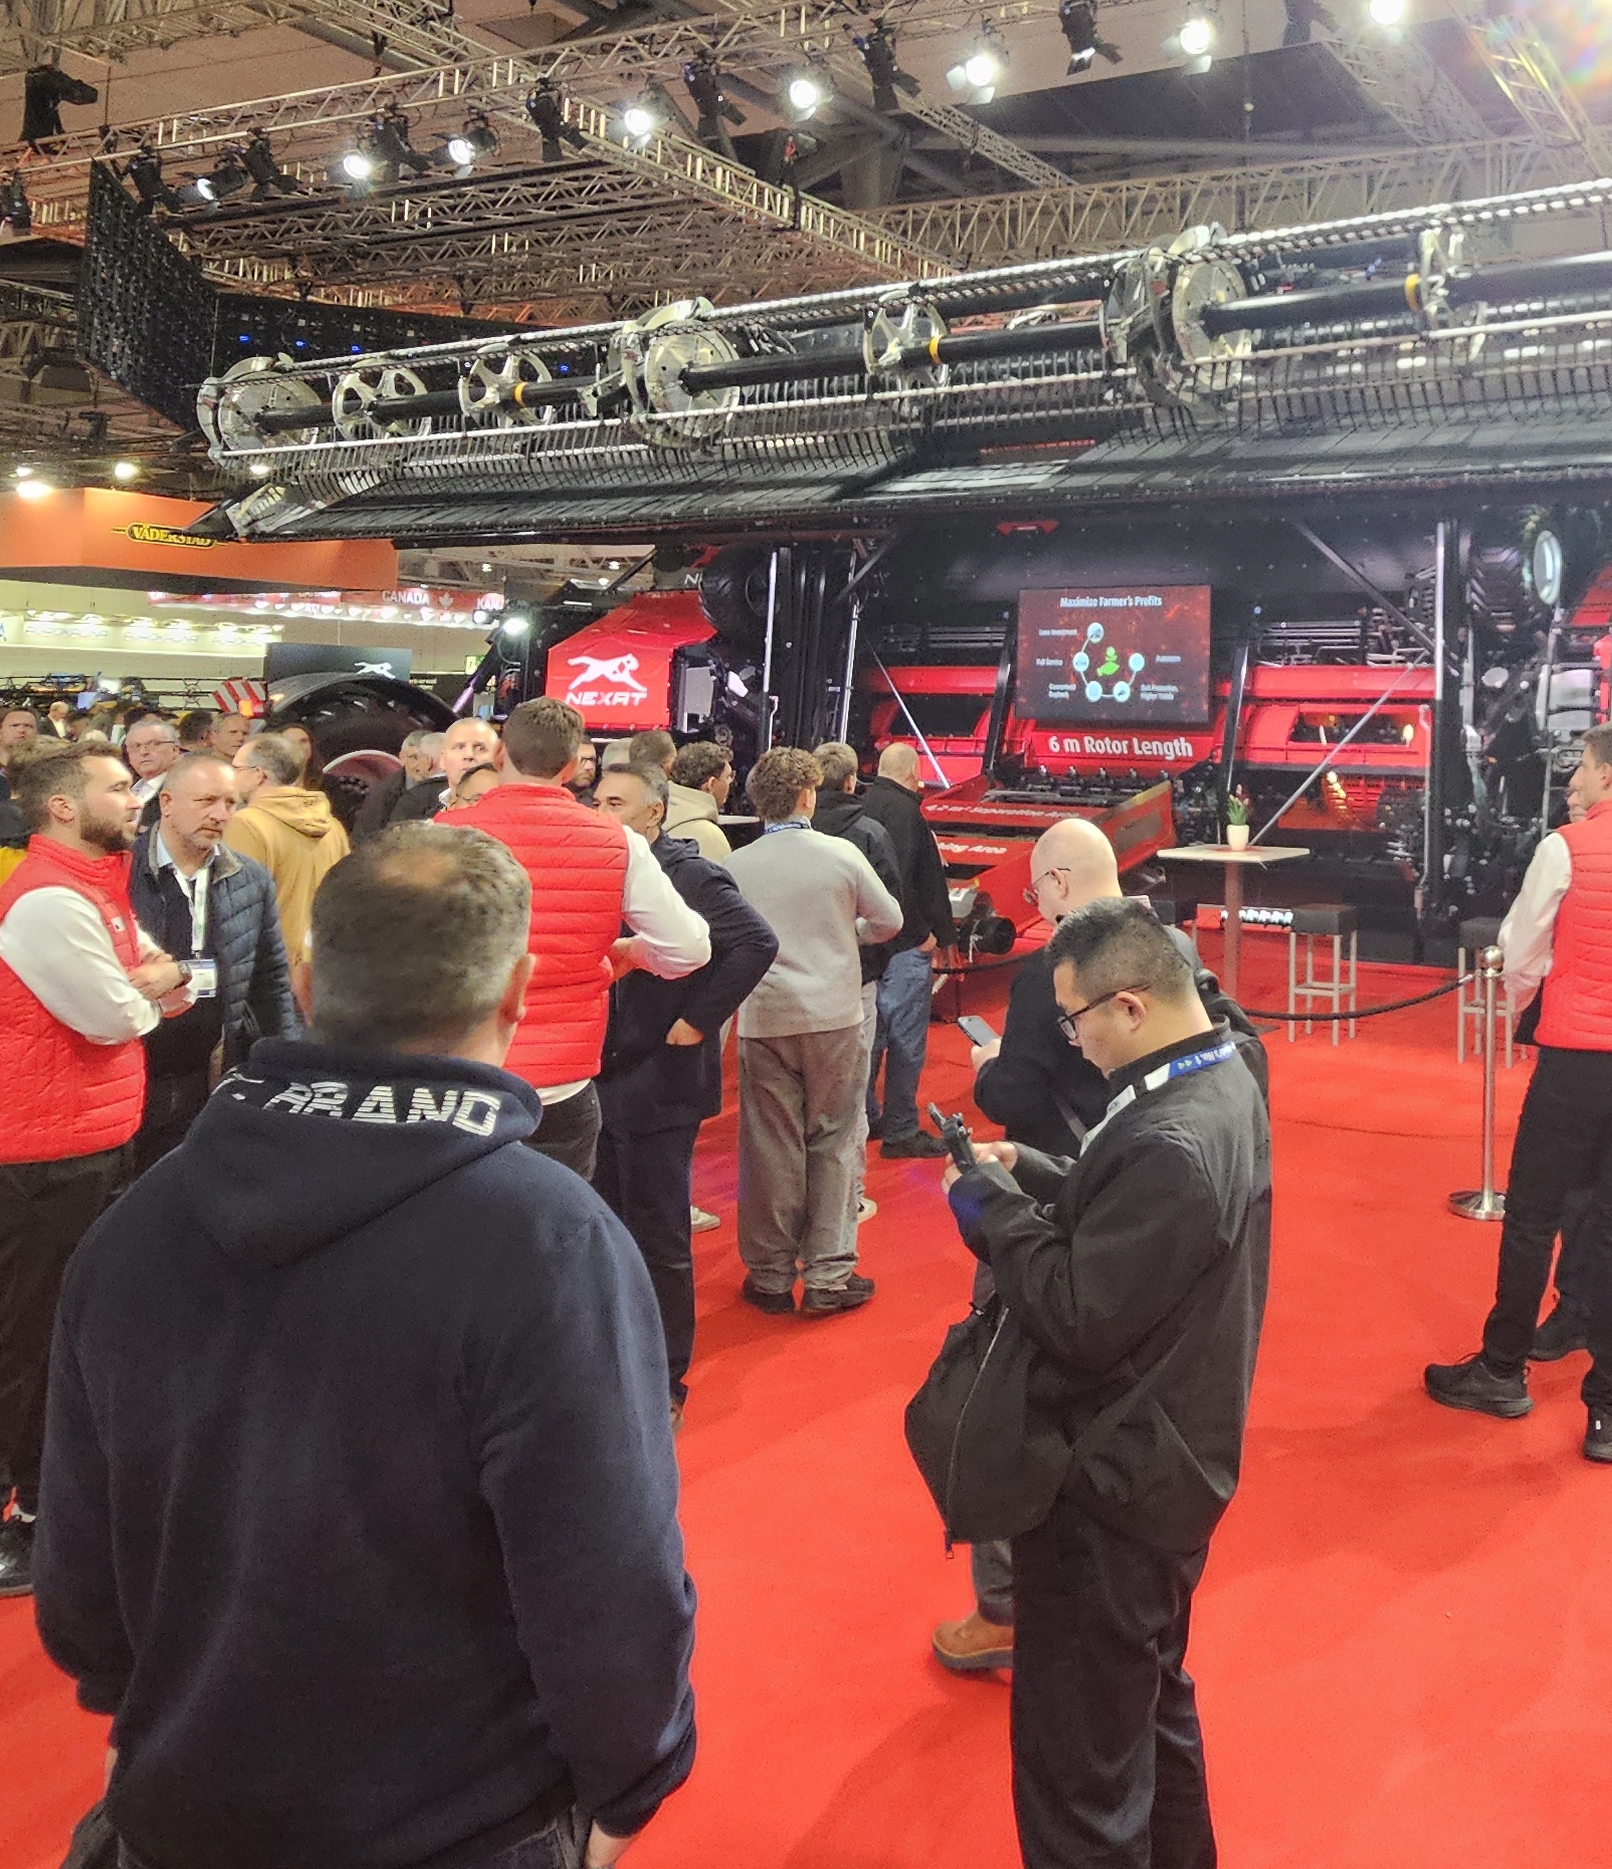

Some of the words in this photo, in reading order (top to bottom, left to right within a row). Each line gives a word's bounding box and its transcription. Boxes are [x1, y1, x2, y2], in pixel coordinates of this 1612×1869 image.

[1060, 595, 1098, 608] Maximize
[1099, 595, 1134, 608] Farmer's
[1134, 594, 1163, 608] Profits
[565, 691, 648, 707] NEXAT
[1048, 735, 1061, 753] 6
[1063, 738, 1081, 753] m
[1083, 735, 1129, 755] Rotor
[1132, 736, 1194, 761] Length
[968, 844, 1008, 855] Area
